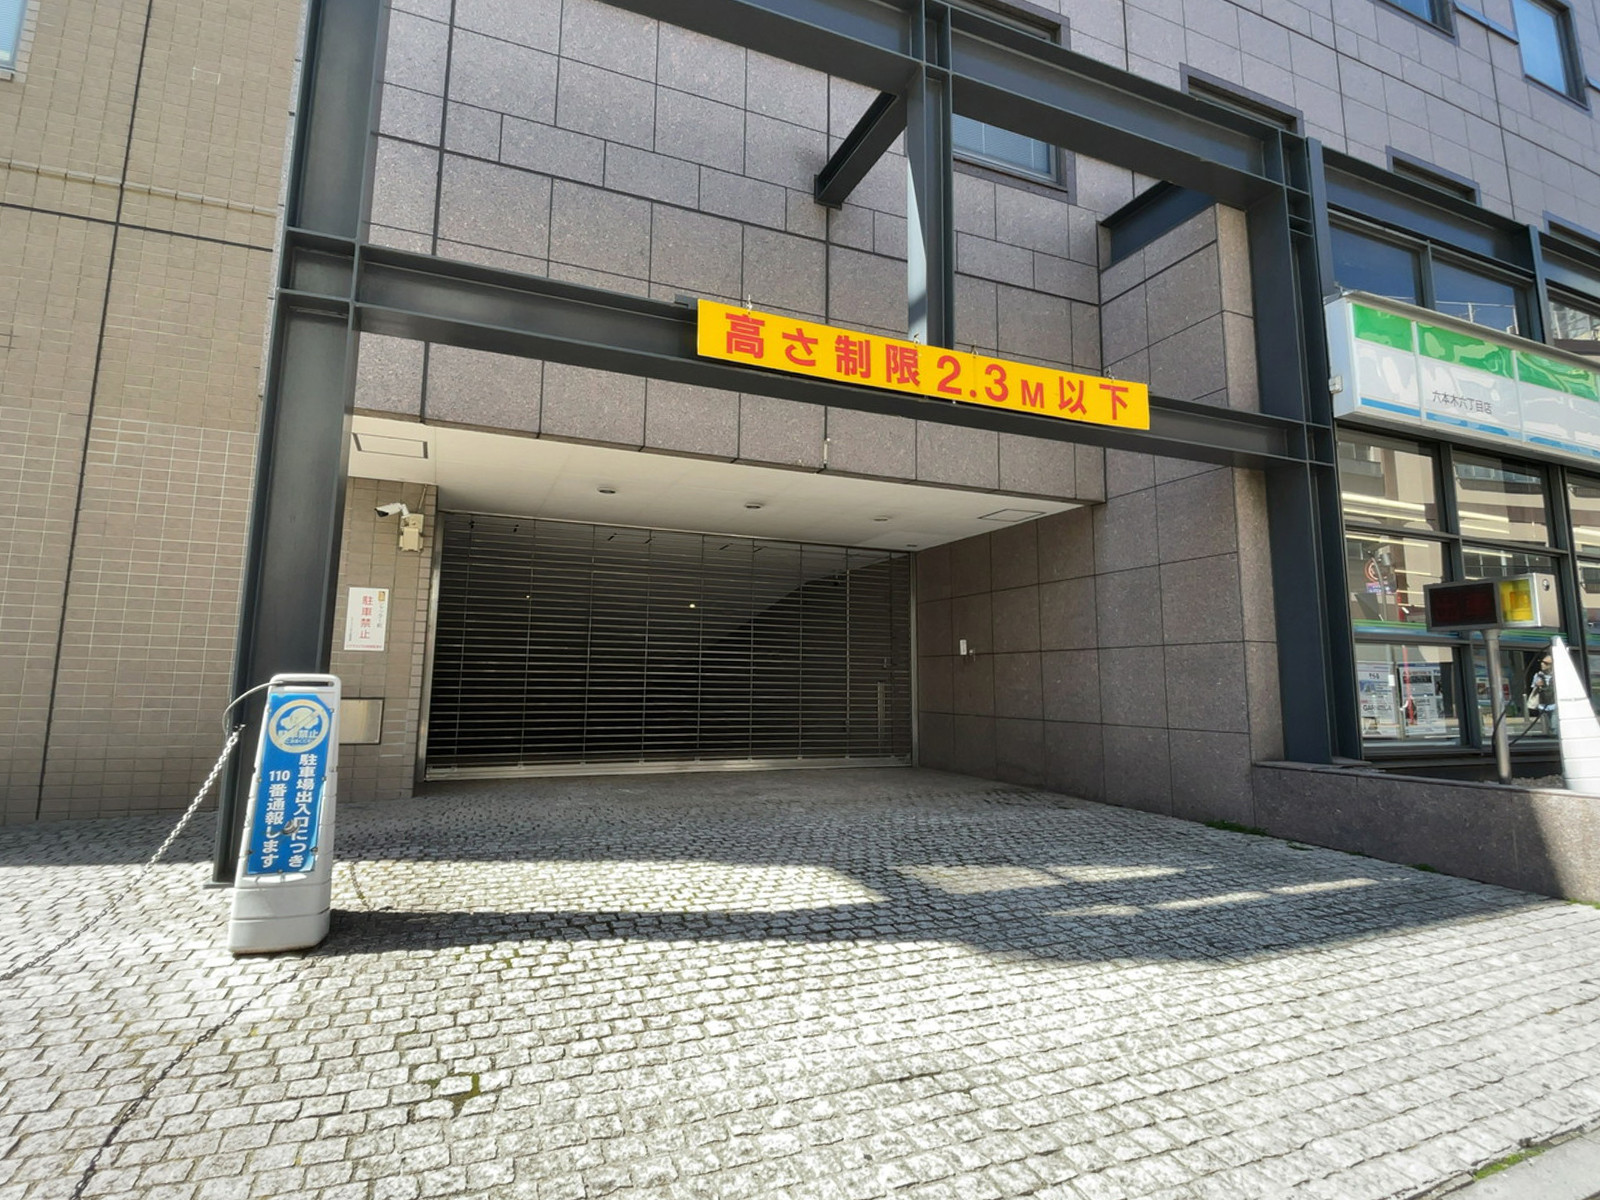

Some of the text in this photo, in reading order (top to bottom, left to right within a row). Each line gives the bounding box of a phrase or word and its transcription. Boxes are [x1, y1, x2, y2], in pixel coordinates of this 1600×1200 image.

[1432, 390, 1492, 415] 六本木六丁目店
[260, 769, 291, 868] 110番通報します
[288, 753, 318, 868] 駐車場出入口につき
